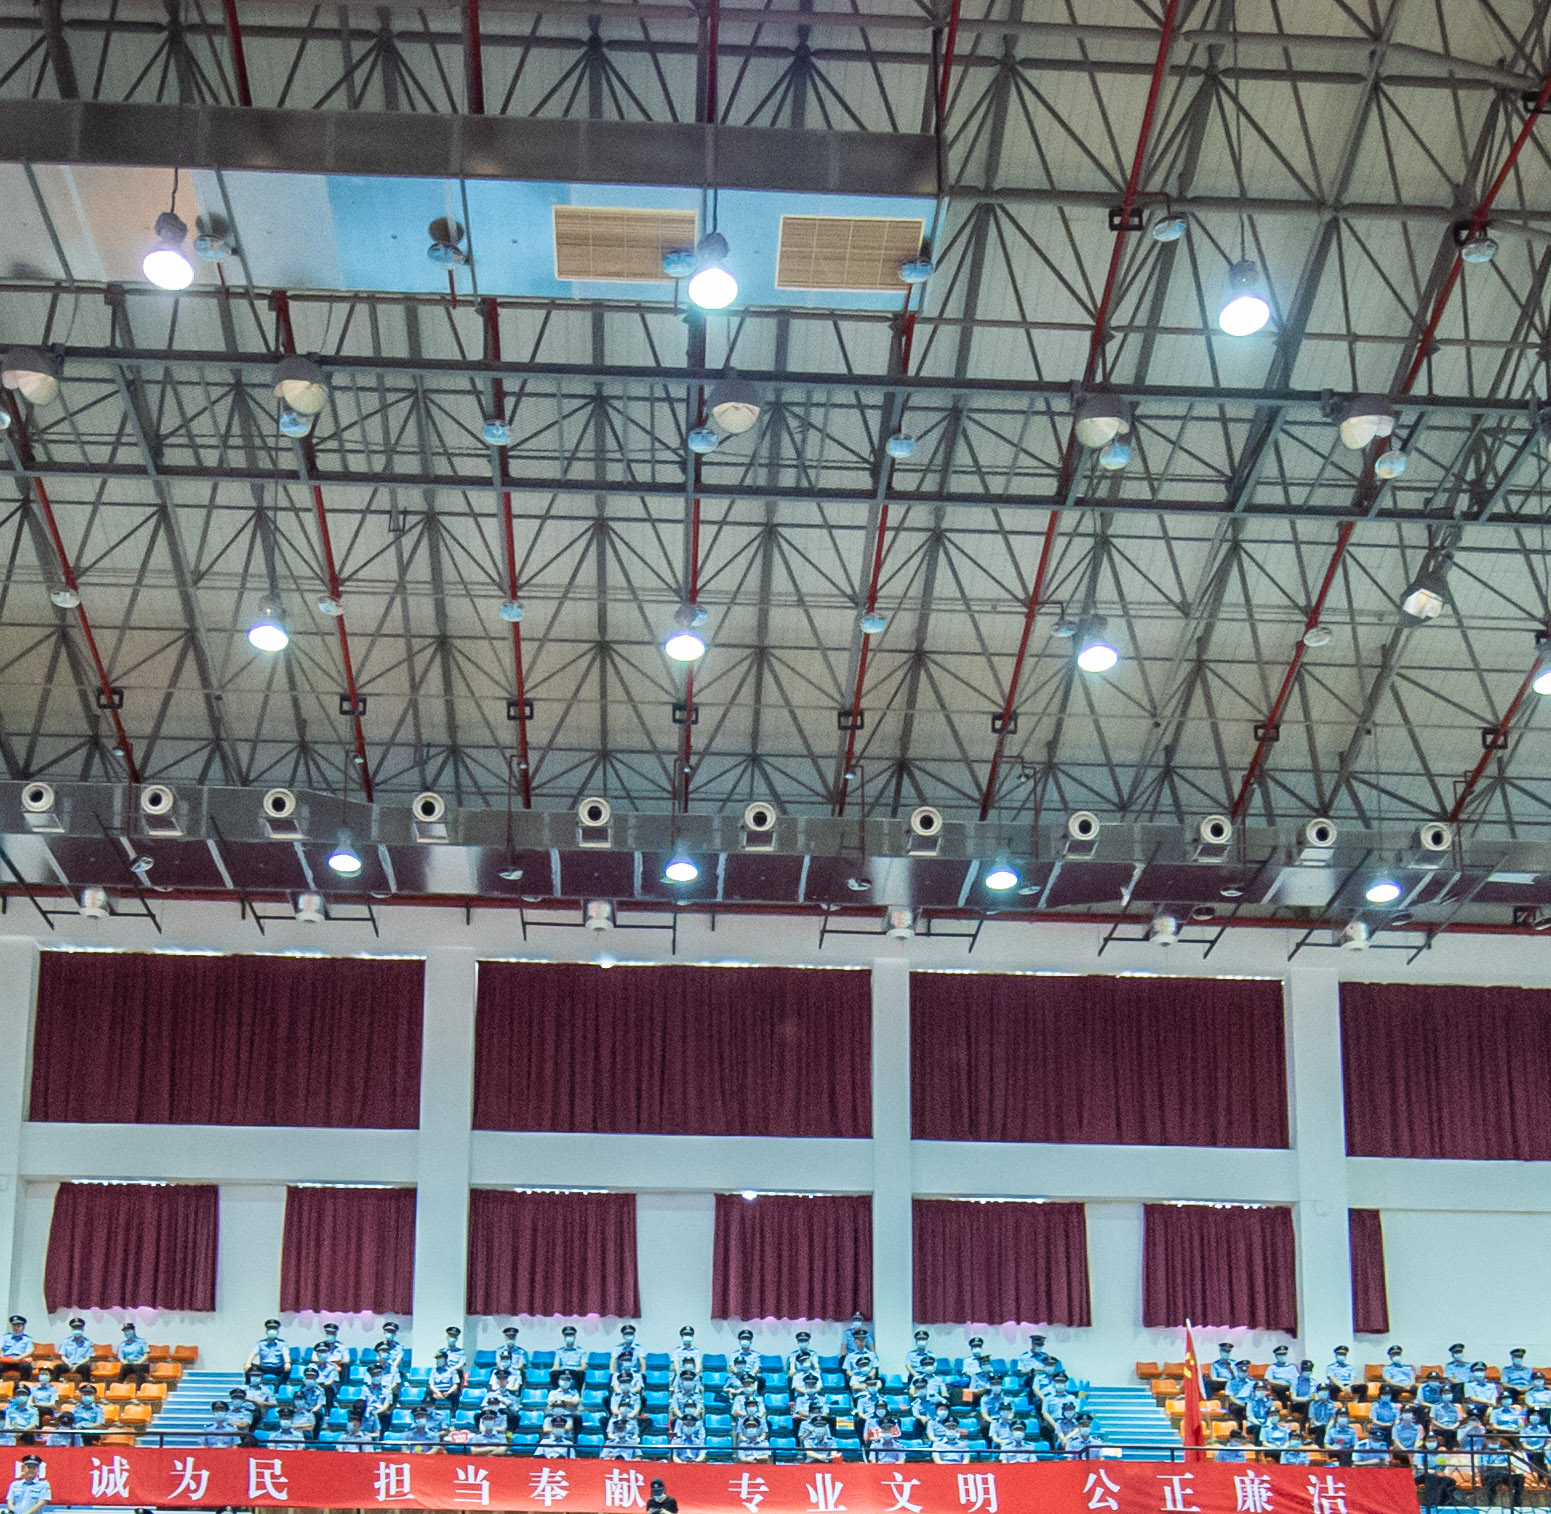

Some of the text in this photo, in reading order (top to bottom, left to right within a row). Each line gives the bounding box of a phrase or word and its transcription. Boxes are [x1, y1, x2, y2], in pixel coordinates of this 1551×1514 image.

[374, 1460, 647, 1507] 担当奉献
[728, 1471, 998, 1514] 专业文明
